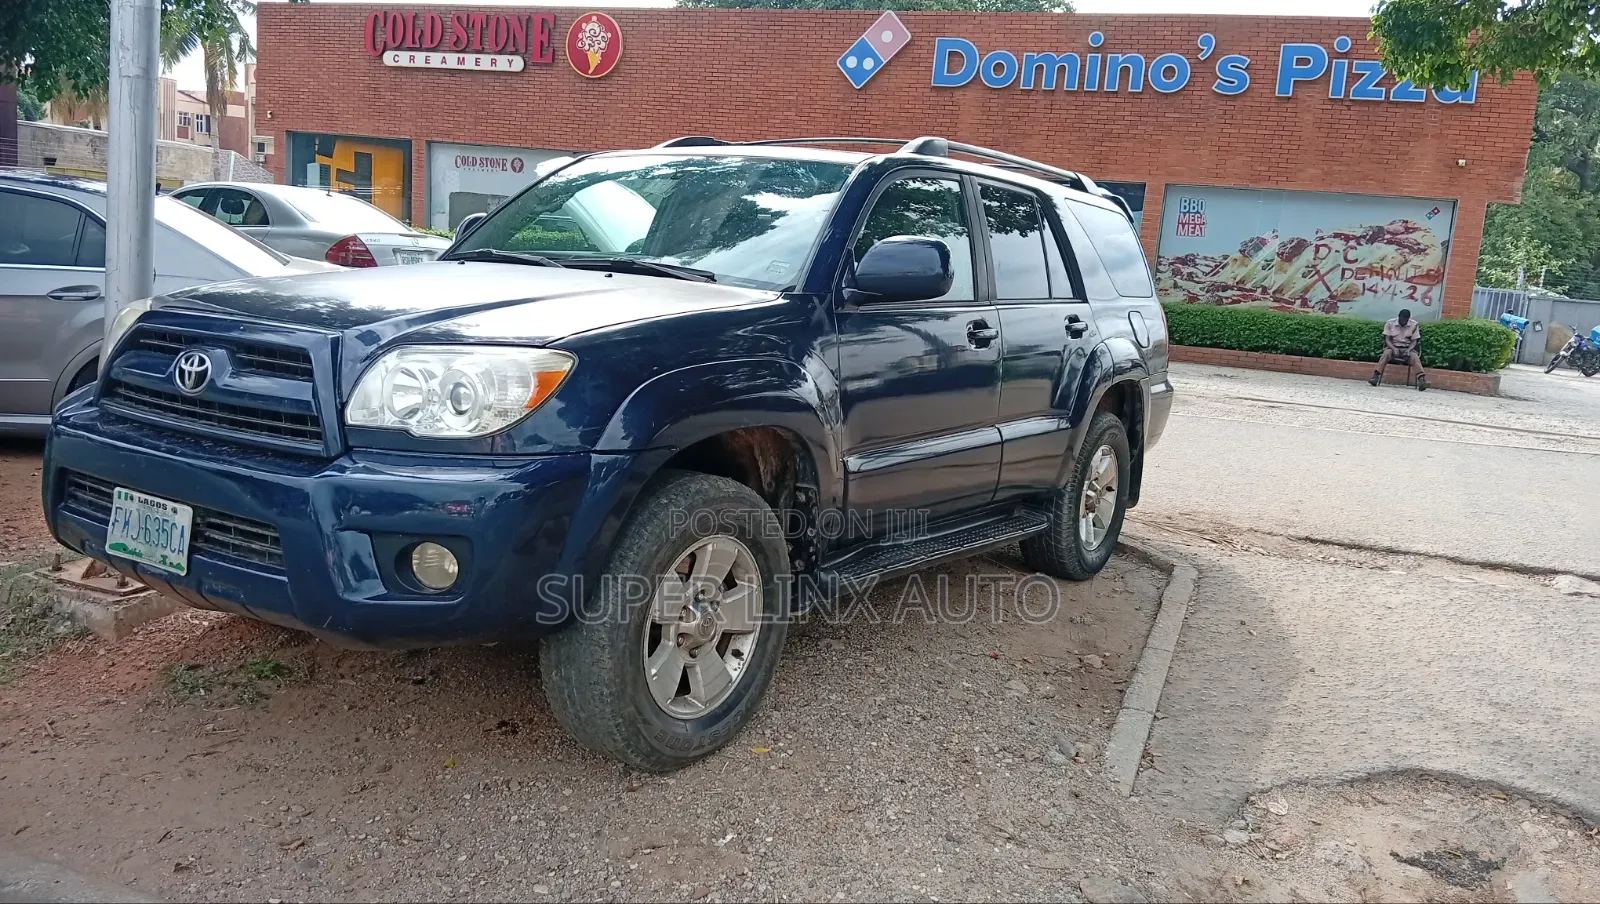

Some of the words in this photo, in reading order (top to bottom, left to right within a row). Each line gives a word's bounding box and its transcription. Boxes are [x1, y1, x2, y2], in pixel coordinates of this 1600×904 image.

[365, 10, 443, 56] COLD
[451, 12, 556, 64] STONE
[392, 54, 514, 69] CREAMERY
[931, 31, 1251, 96] Domino's
[455, 155, 477, 168] COLD
[479, 157, 508, 172] STONE
[1180, 197, 1205, 214] BBQ
[1178, 213, 1207, 225] MEGA
[1176, 224, 1206, 237] MEAT
[137, 496, 168, 511] LAGOS
